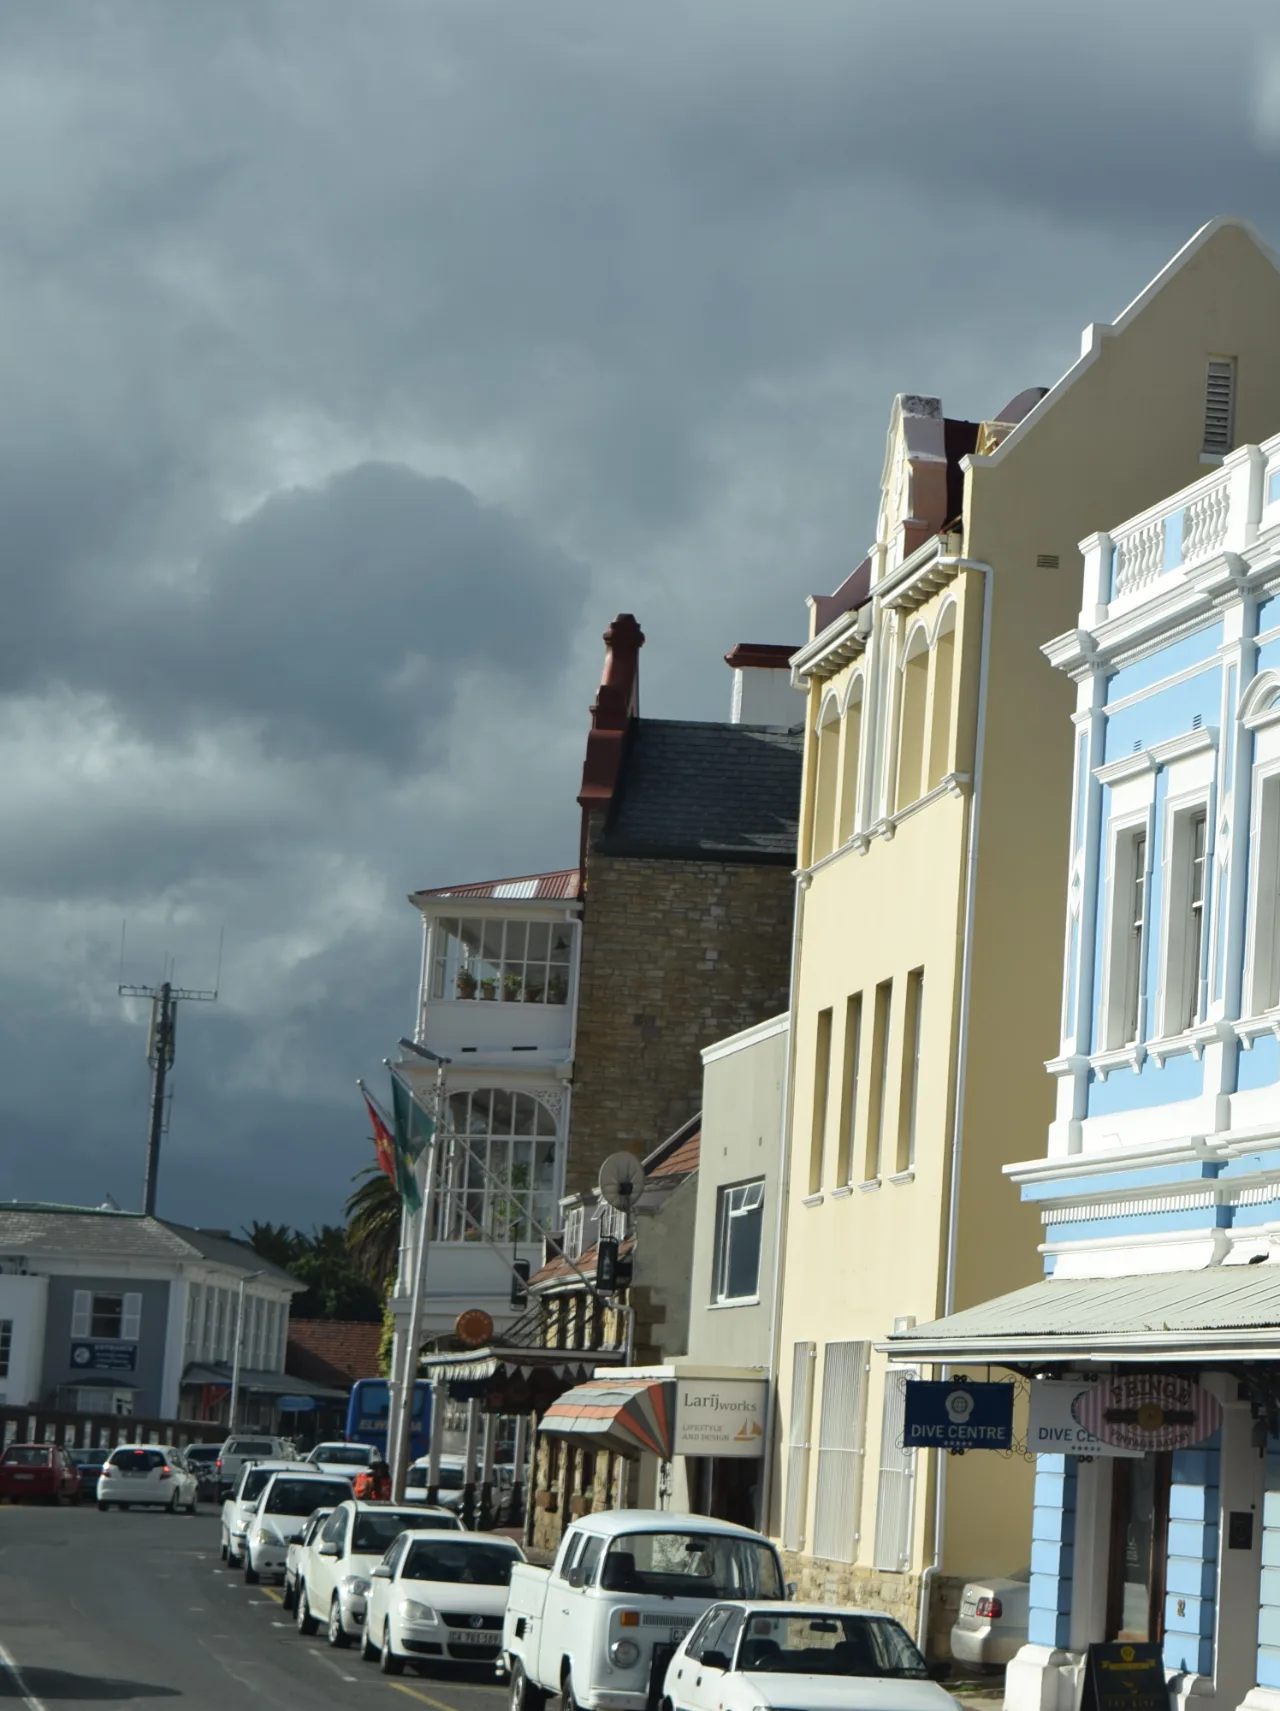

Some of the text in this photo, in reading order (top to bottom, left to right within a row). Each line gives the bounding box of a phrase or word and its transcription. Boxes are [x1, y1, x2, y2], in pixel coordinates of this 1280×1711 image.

[1110, 1379, 1191, 1406] FRINGE
[682, 1424, 723, 1432] LIFESTYLE
[911, 1424, 1006, 1440] DIVE CENTRE
[1038, 1427, 1073, 1442] DIVE
[682, 1433, 730, 1442] AND DESIGN
